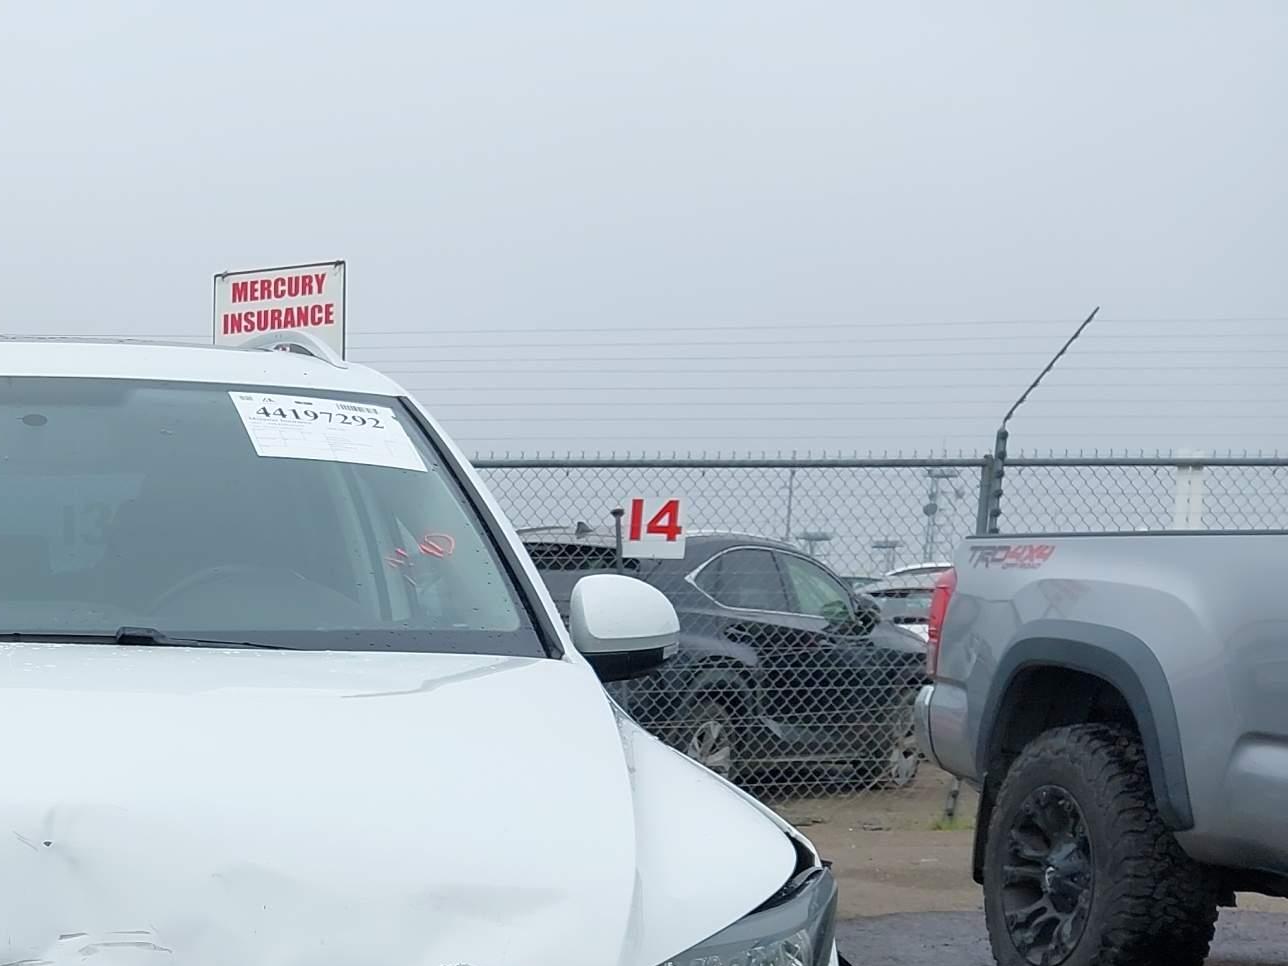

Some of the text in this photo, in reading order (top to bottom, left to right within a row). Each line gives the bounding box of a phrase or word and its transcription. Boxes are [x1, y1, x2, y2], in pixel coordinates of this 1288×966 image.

[231, 273, 327, 303] MERCURY
[223, 303, 334, 335] INSURANCE
[256, 405, 385, 430] 44197292
[629, 498, 682, 542] 14
